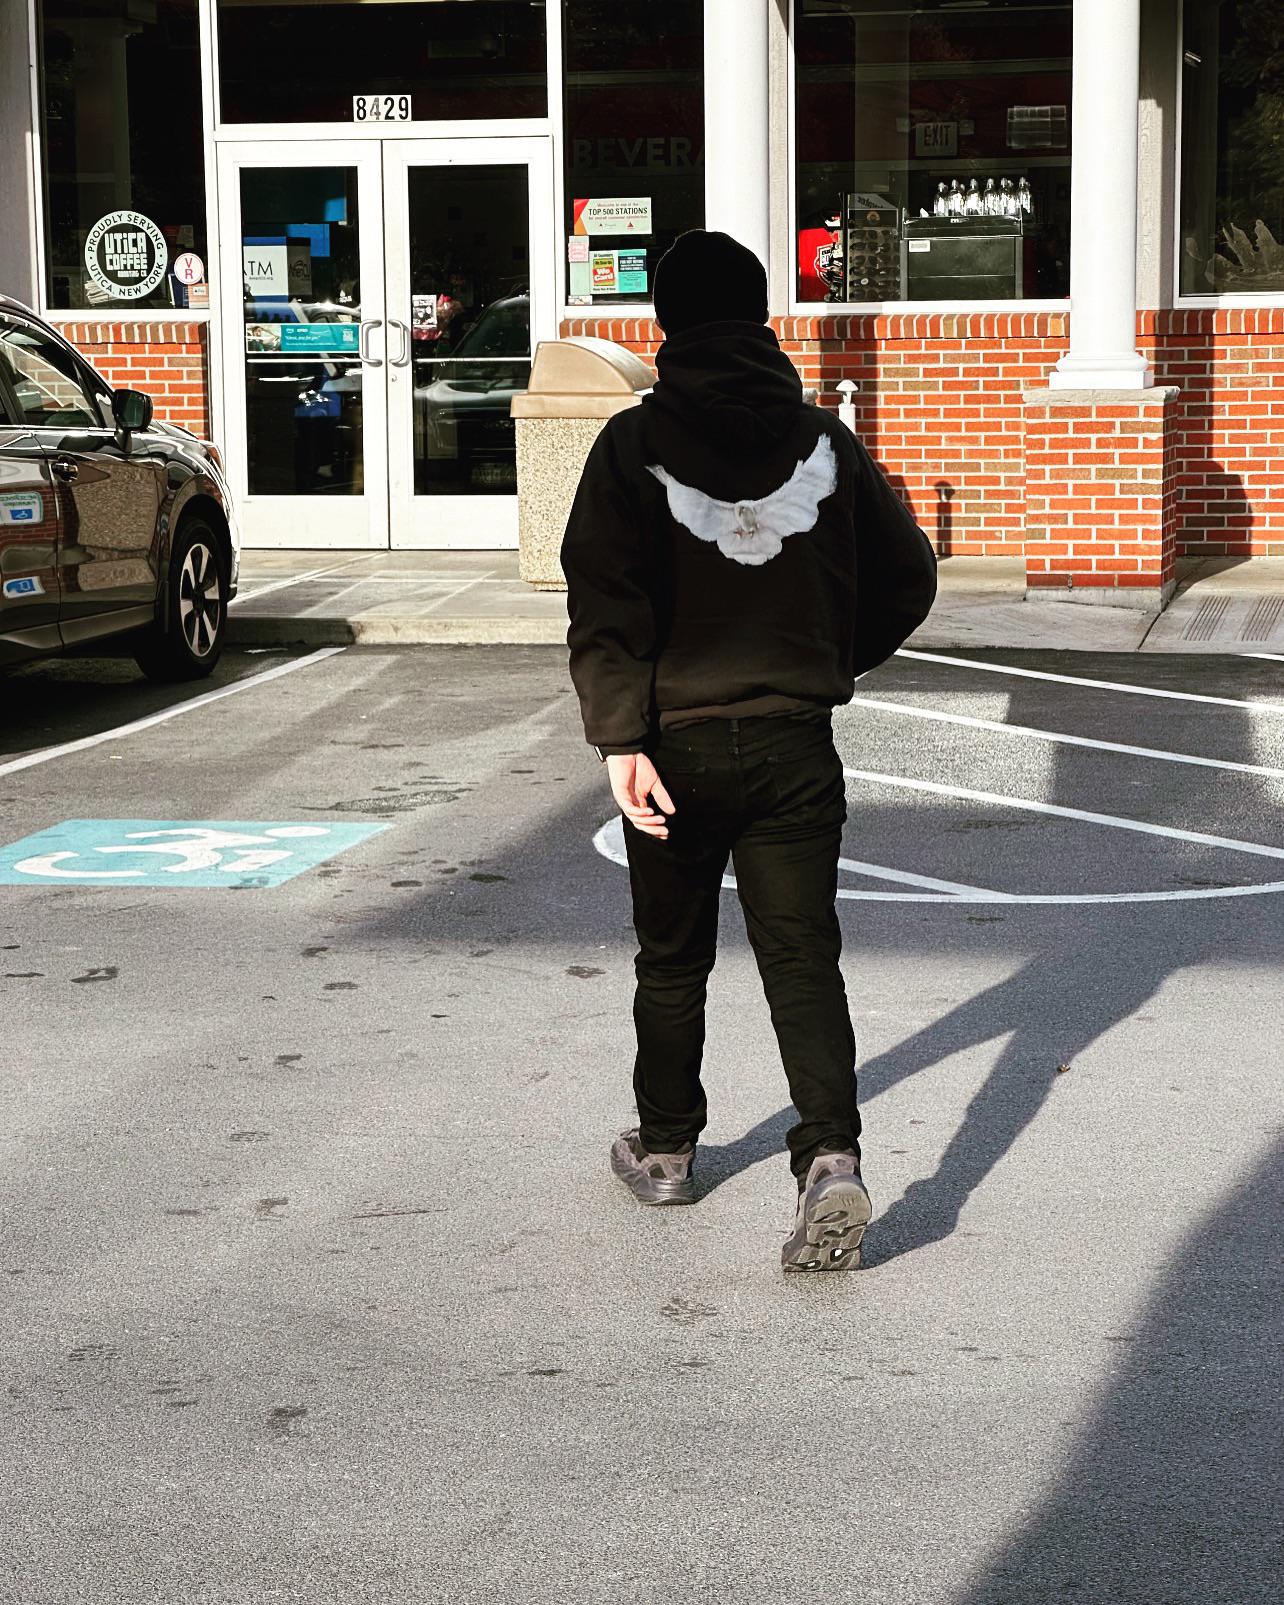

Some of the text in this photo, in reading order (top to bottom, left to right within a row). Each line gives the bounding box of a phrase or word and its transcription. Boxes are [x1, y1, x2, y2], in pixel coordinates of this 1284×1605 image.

[356, 96, 409, 121] 8429
[923, 125, 950, 147] EXIT
[588, 207, 648, 216] TOP 500 STATIONS
[87, 213, 164, 252] PROUDLY SERVING
[105, 253, 148, 271] COFFEE
[243, 260, 274, 276] TM
[118, 285, 141, 297] NEW
[143, 263, 164, 289] YORK
